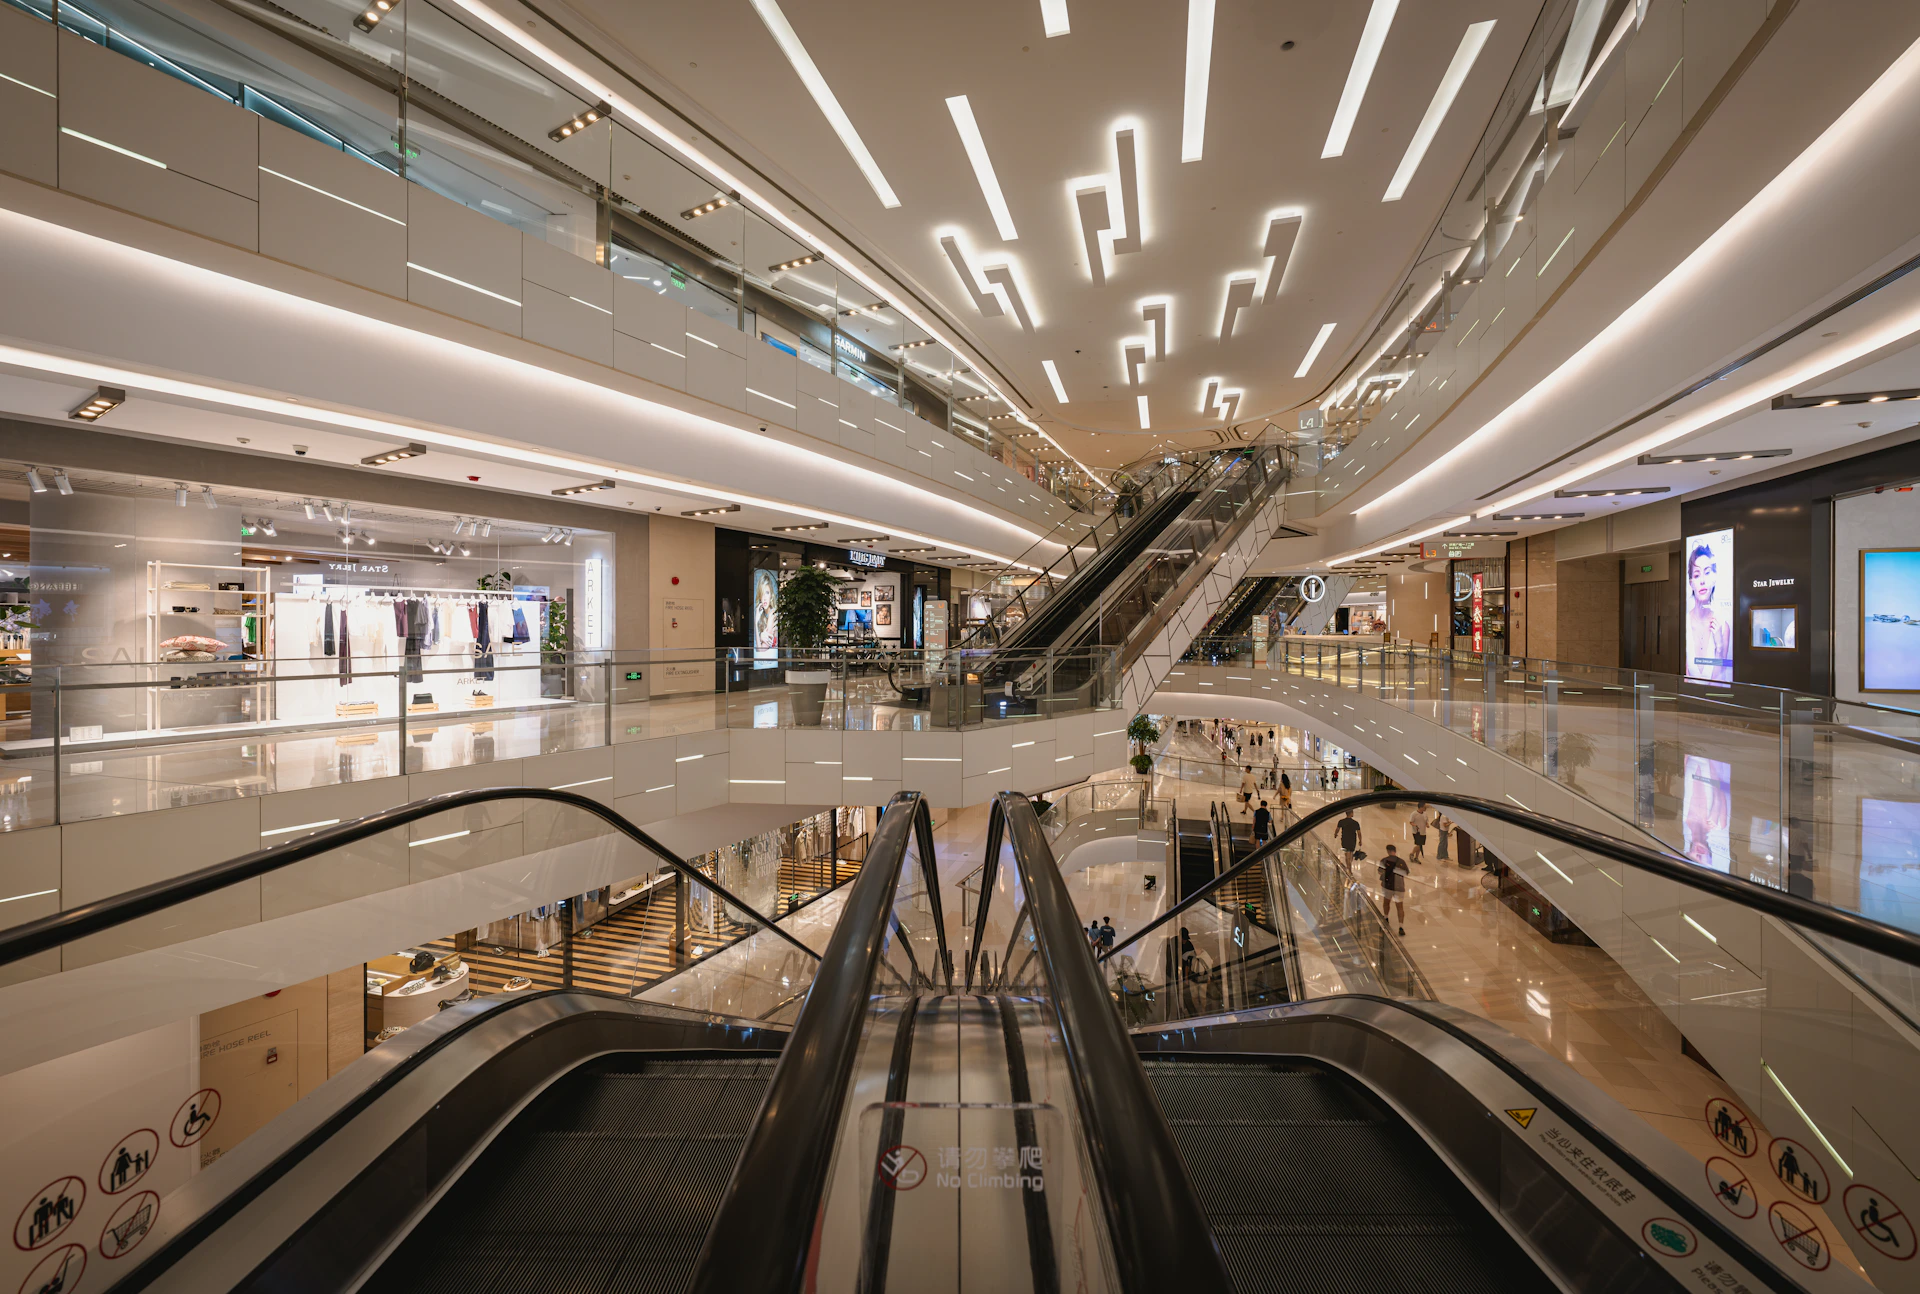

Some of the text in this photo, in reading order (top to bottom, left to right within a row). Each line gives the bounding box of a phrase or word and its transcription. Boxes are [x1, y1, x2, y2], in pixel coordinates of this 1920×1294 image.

[1768, 578, 1795, 587] JEWELRY
[473, 641, 523, 659] SALE
[457, 676, 487, 685] ARKET
[218, 1038, 245, 1053] HOSE
[247, 1030, 272, 1043] REEL
[938, 1146, 1042, 1170] 请勿攀爬
[1544, 1127, 1636, 1204] 当心夹住软底鞋
[936, 1173, 1044, 1192] No Climbing
